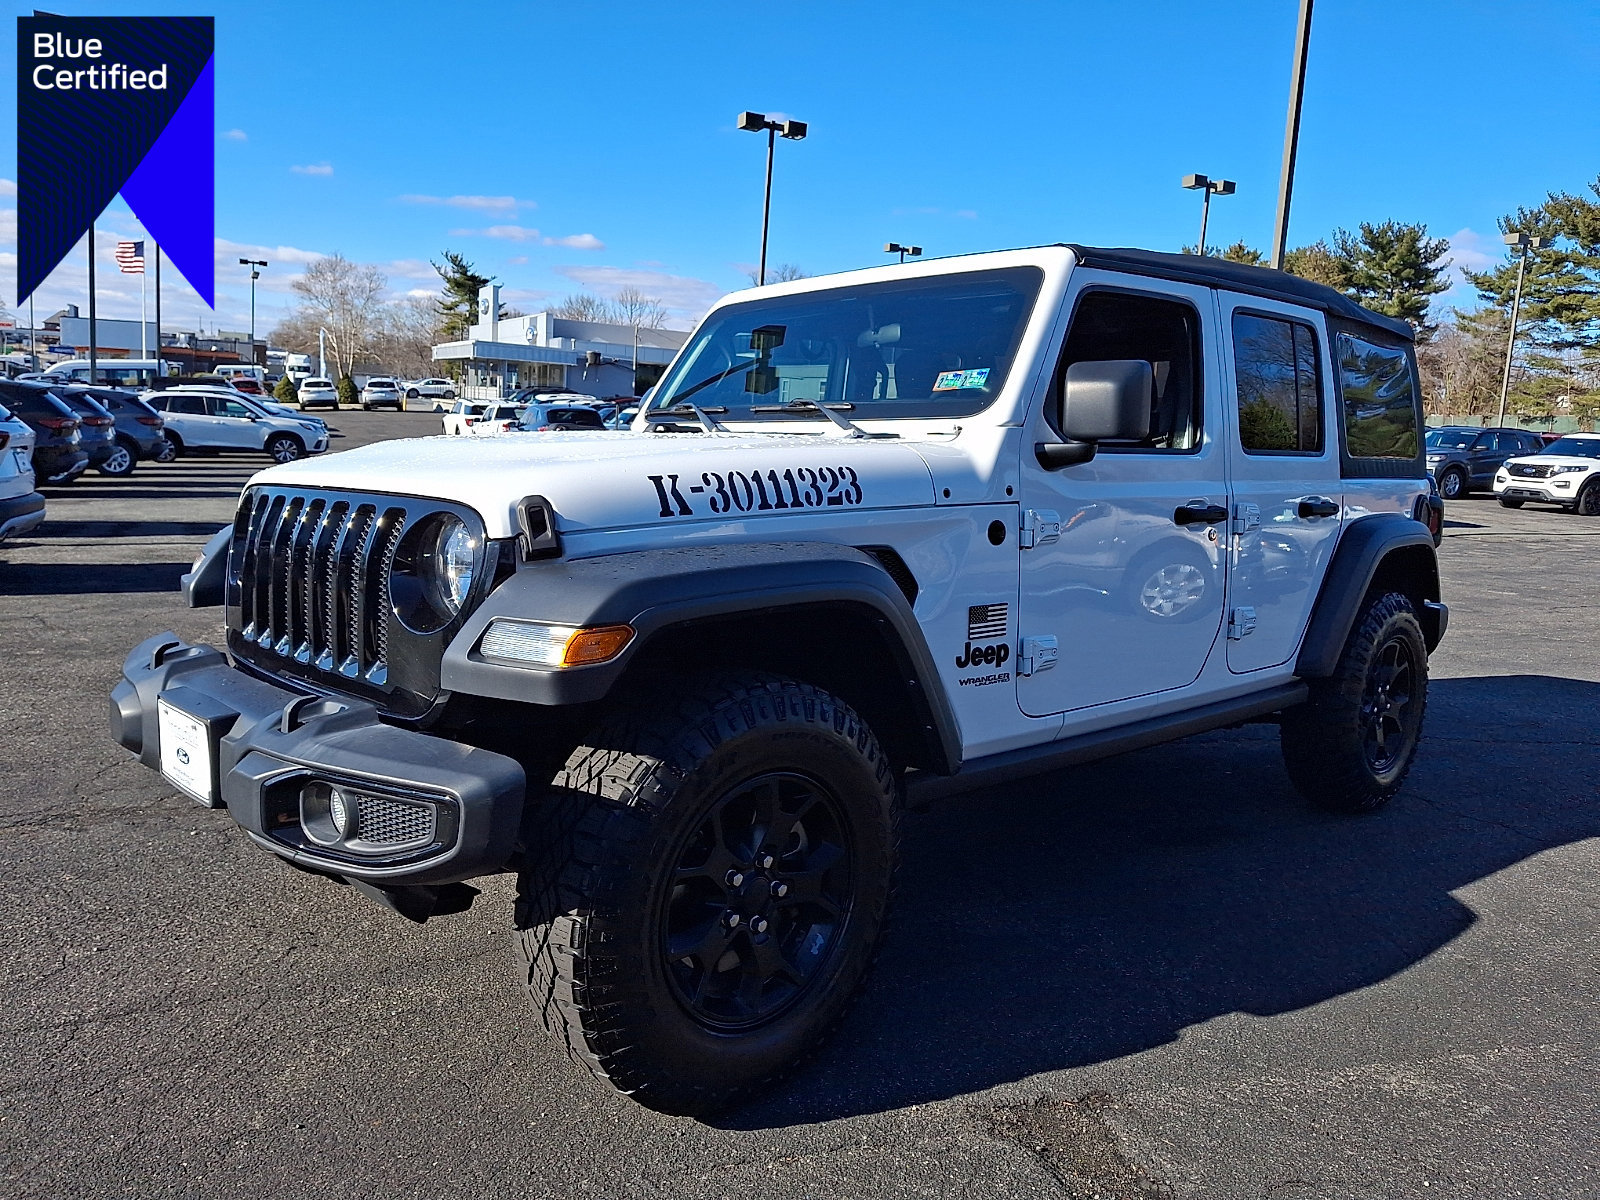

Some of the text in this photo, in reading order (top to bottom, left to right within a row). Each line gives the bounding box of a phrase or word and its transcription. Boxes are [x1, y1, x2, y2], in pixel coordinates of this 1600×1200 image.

[647, 466, 863, 518] K-30111323
[955, 641, 1010, 669] Jeep
[958, 672, 1010, 687] WRANGLER
